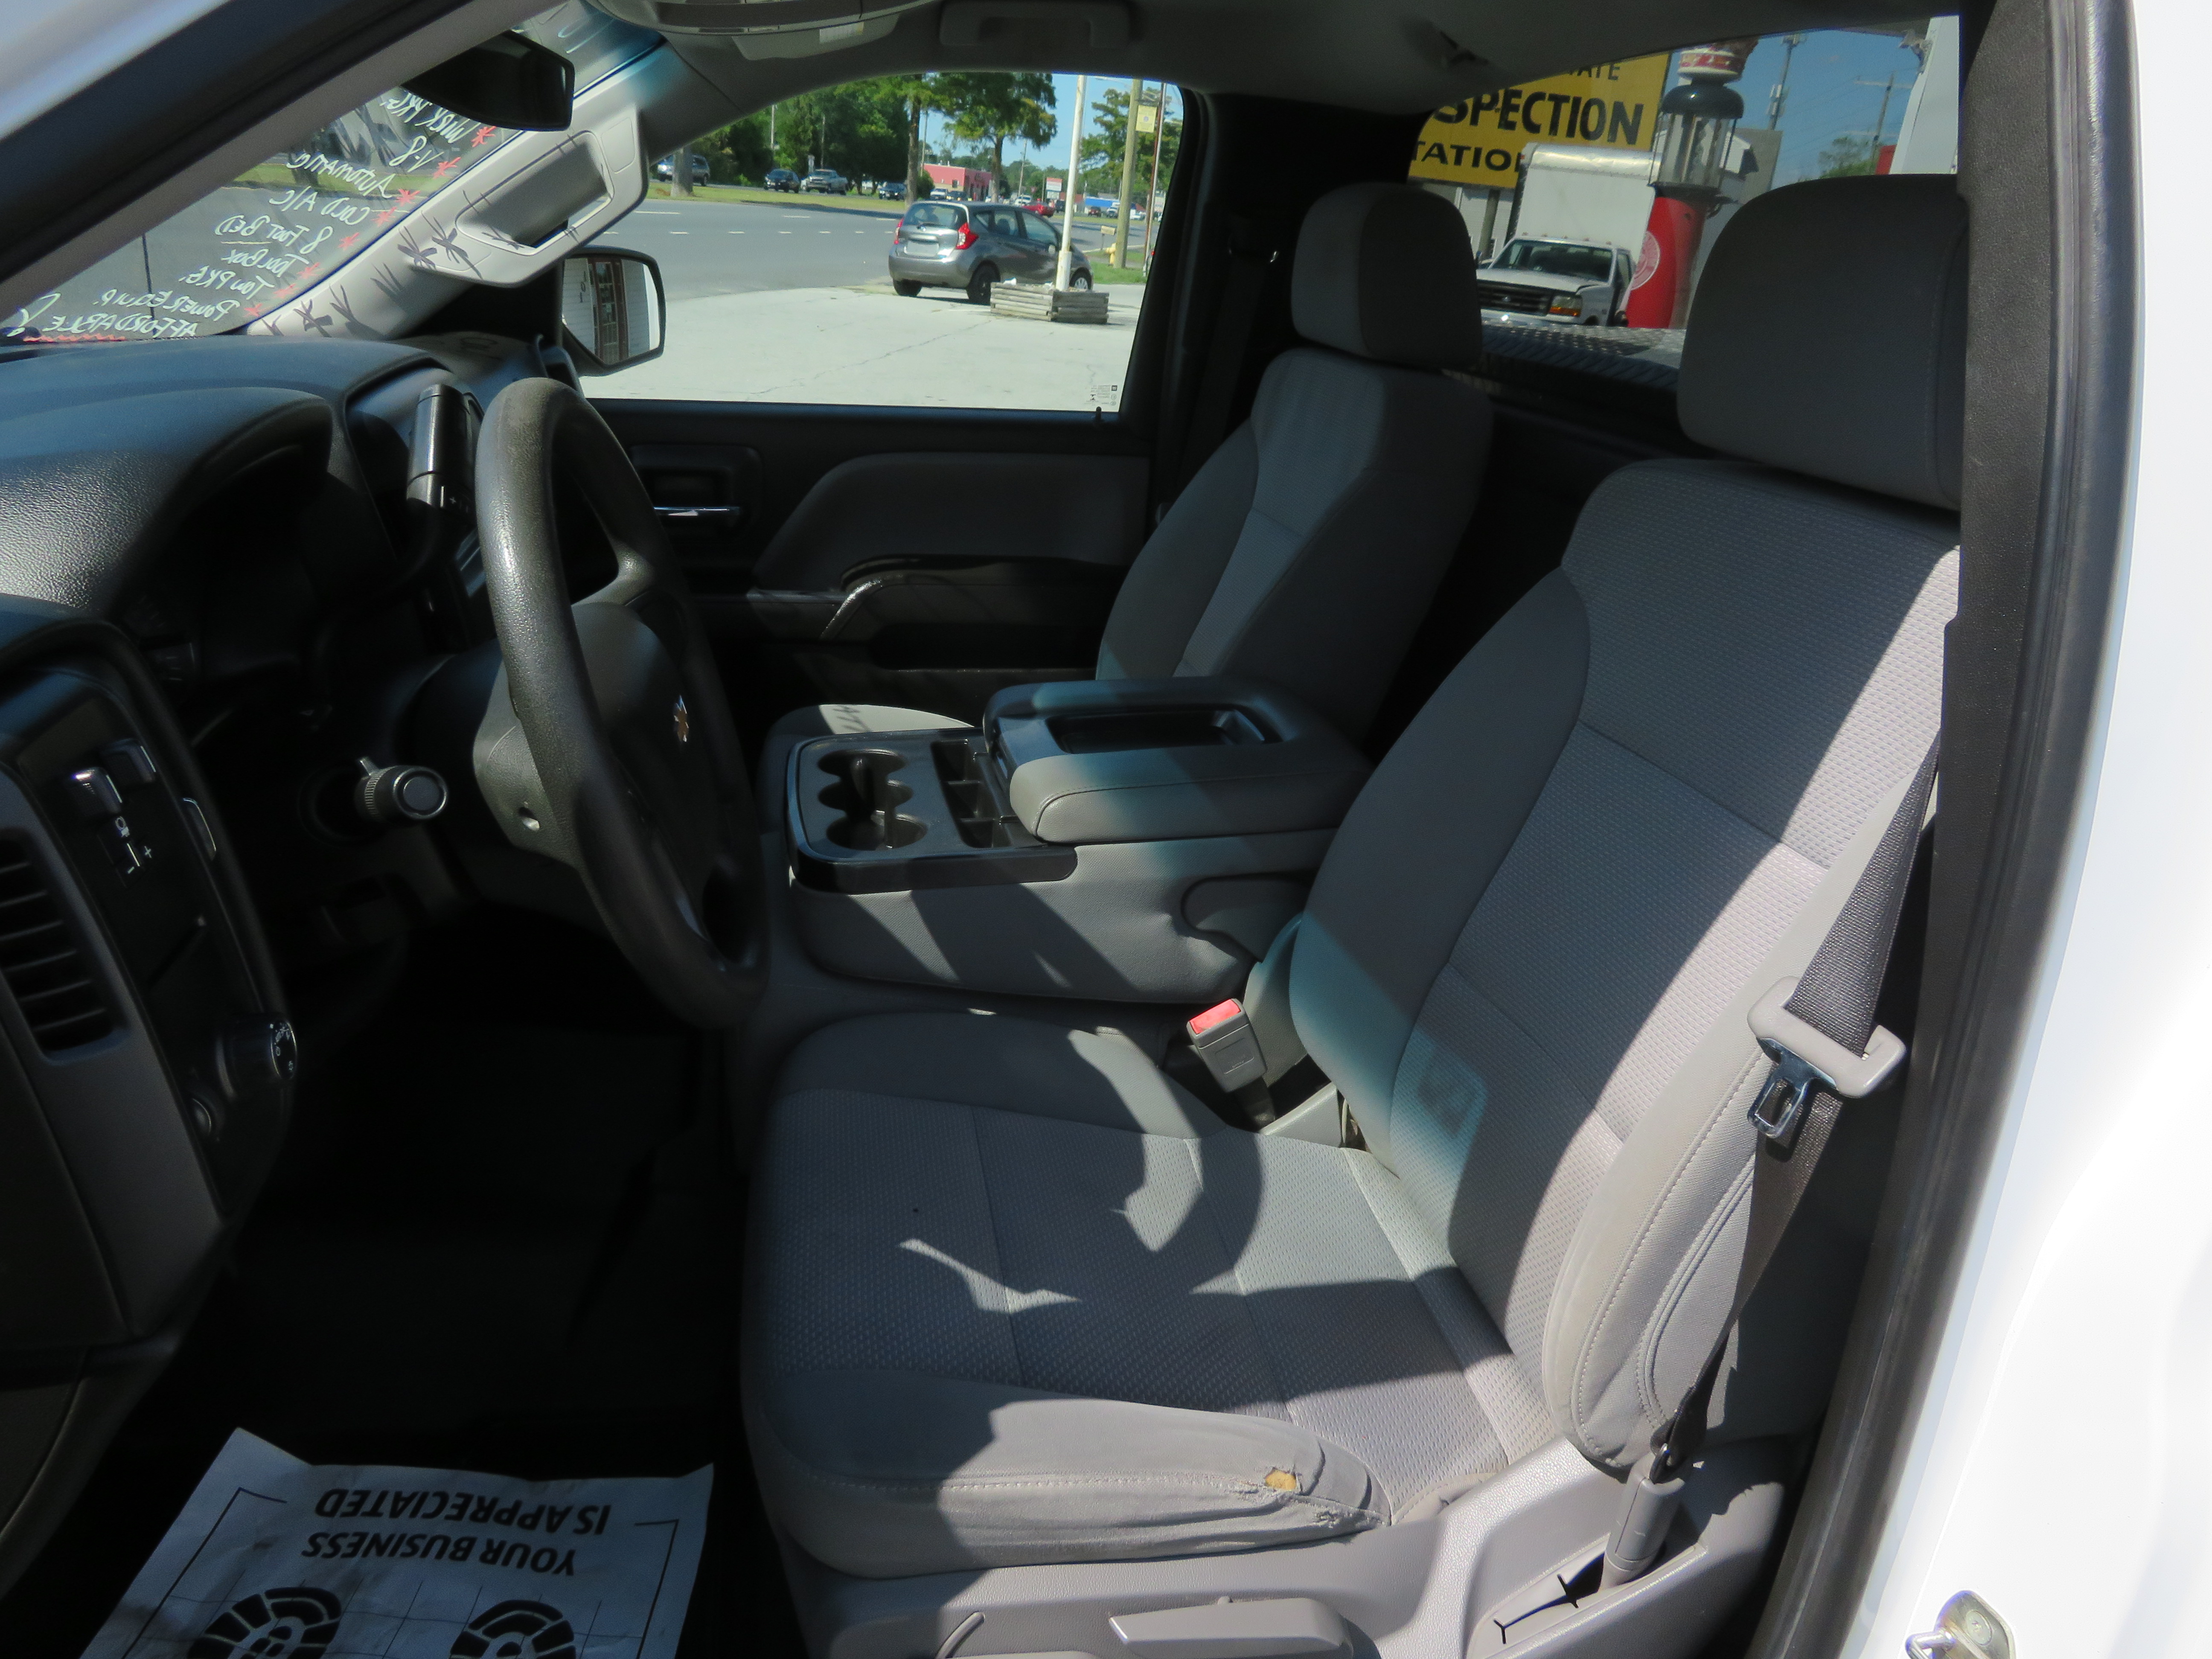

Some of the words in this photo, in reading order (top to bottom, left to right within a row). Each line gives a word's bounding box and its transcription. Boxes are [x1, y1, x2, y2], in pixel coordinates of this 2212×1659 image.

[314, 1488, 574, 1534] APPRECIATED
[573, 1504, 611, 1535] IS
[301, 1531, 477, 1562] BUSINESS
[479, 1538, 576, 1576] YOUR
